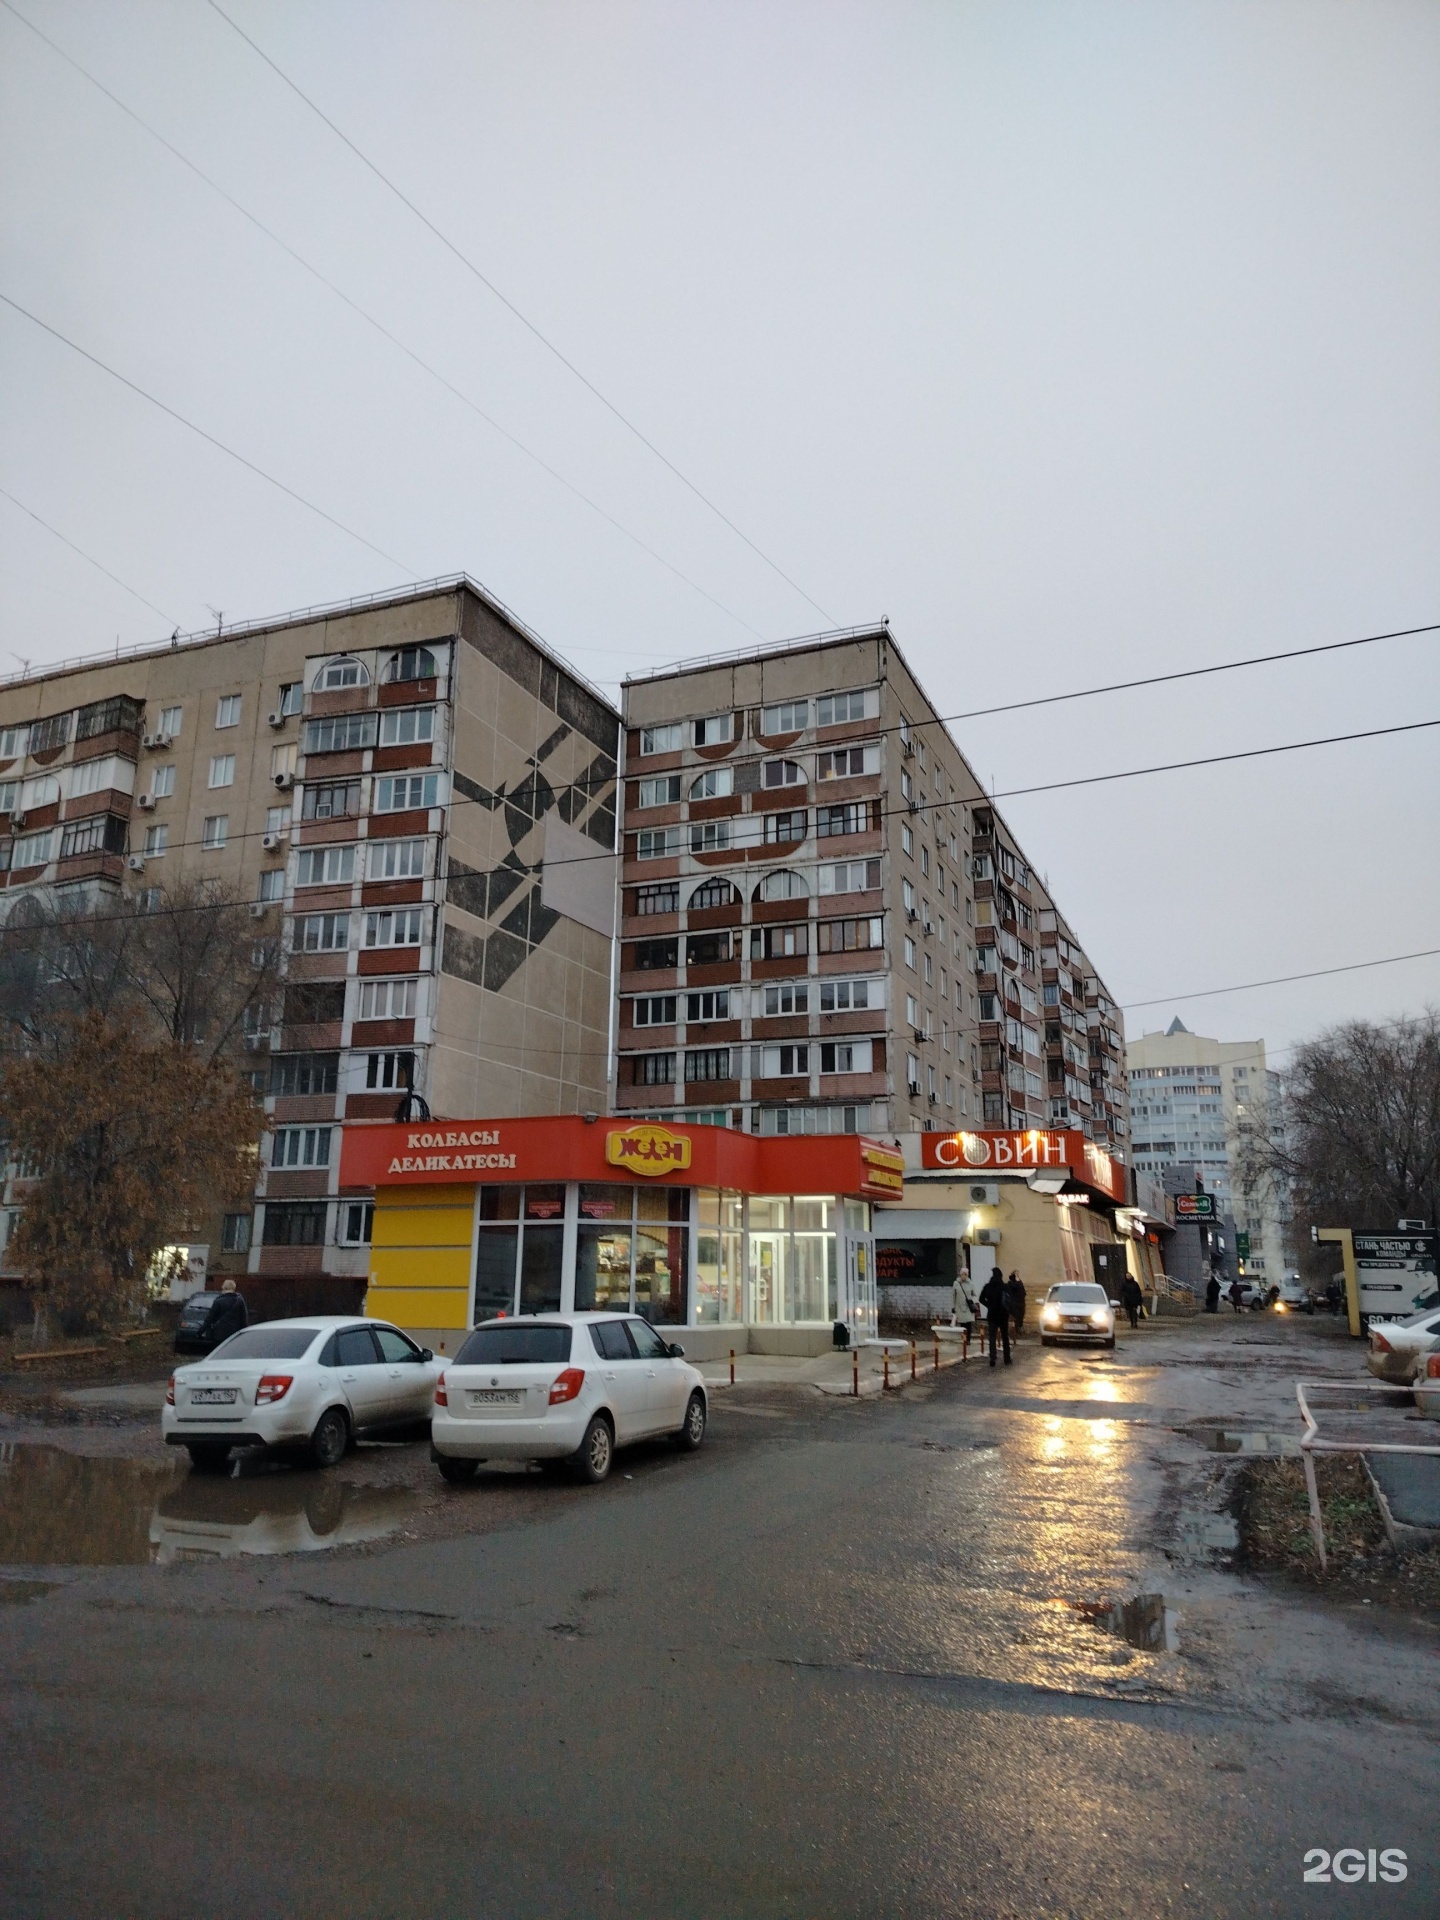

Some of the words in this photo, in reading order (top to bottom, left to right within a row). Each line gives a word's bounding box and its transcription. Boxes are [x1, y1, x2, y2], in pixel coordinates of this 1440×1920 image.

[407, 1130, 500, 1149] КОЛБАСЫ
[935, 1136, 1067, 1165] СОВИН
[388, 1153, 517, 1174] ДЕЛИКАТЕСЫ
[1355, 1241, 1379, 1251] СТАНЬ
[1379, 1241, 1411, 1251] ЧАСТЬЮ
[1375, 1250, 1407, 1258] КОМАНДЫ
